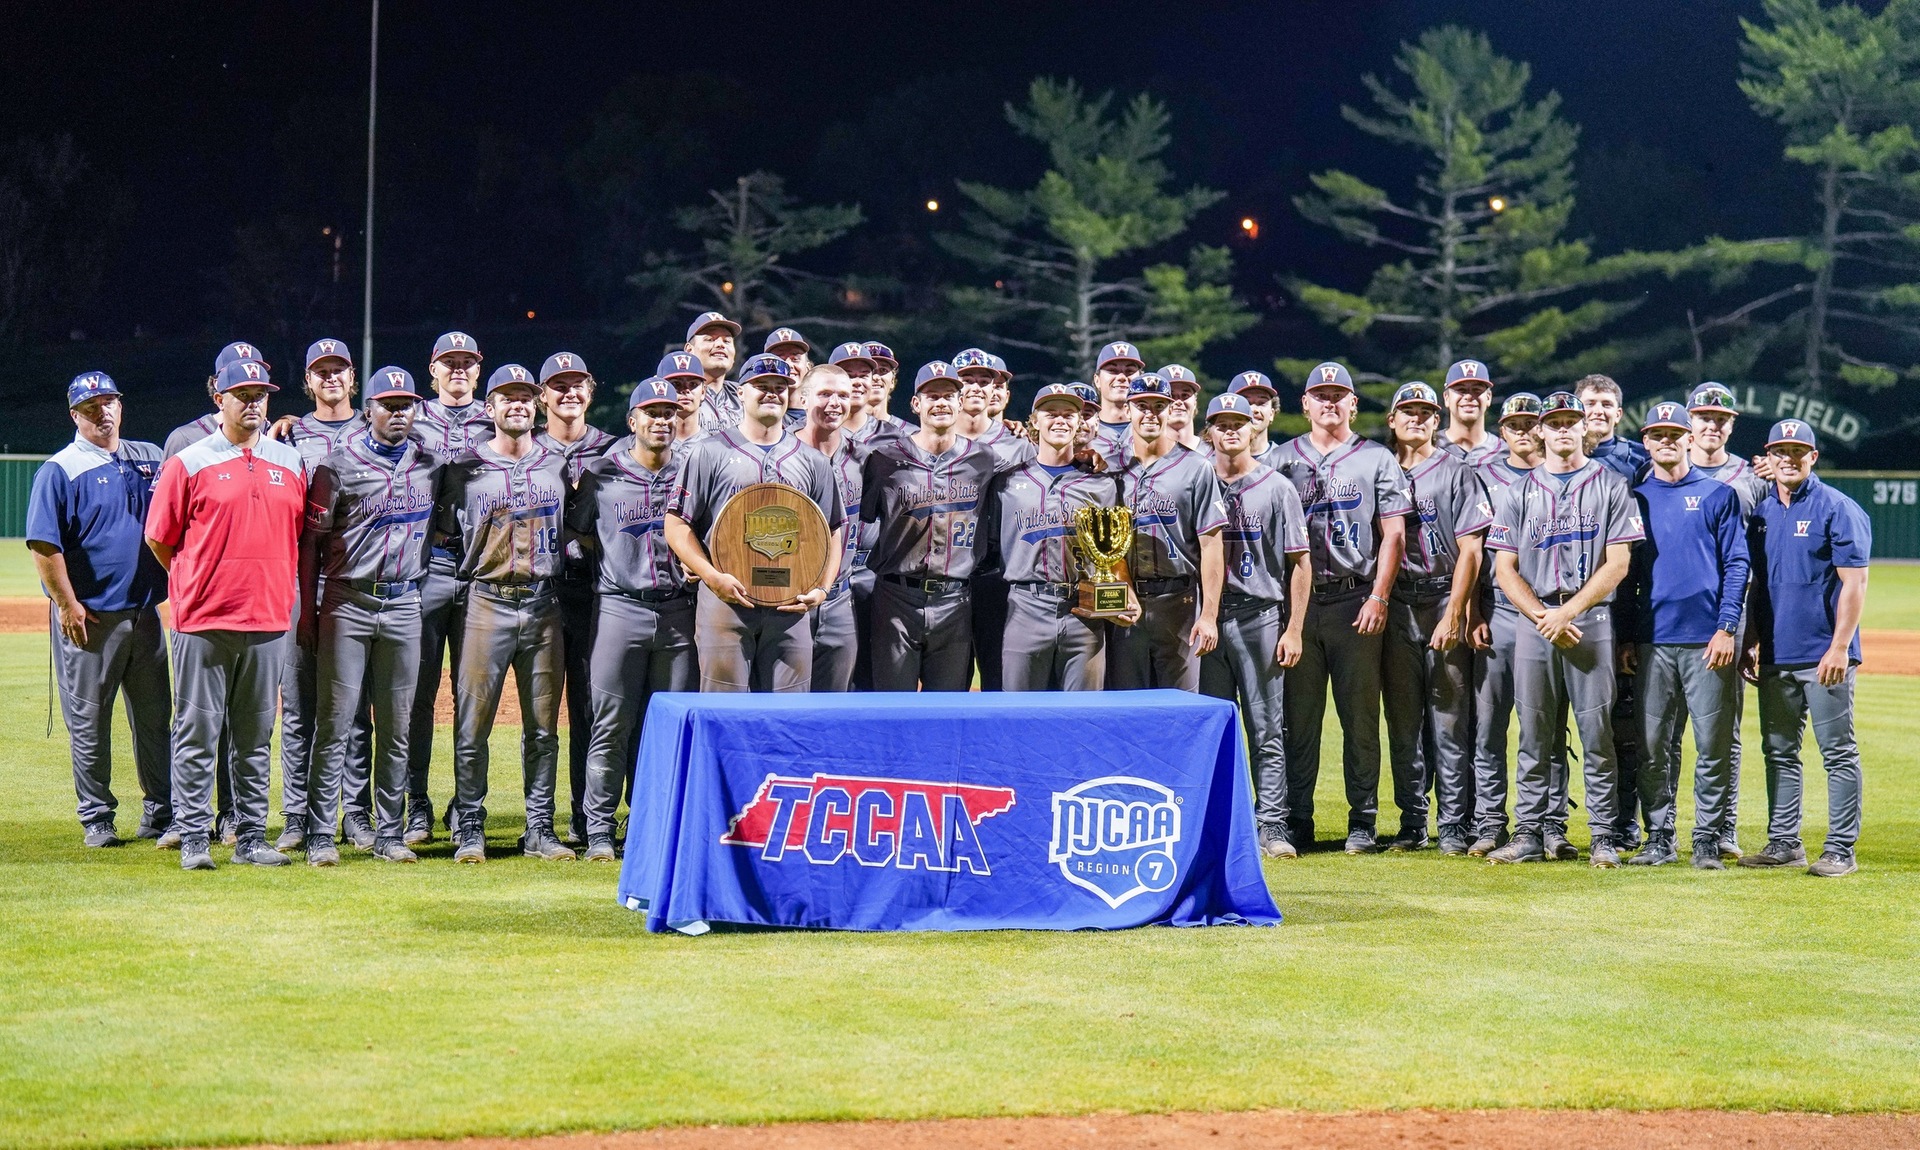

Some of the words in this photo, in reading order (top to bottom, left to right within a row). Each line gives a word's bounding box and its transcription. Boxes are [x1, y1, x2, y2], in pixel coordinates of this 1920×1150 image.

[449, 333, 467, 347] W
[776, 329, 793, 341] W
[234, 344, 252, 358] W
[318, 342, 336, 353] W
[1112, 344, 1130, 357] W
[555, 355, 572, 369] W
[673, 355, 692, 370] W
[241, 363, 260, 379] W
[508, 367, 527, 381] W
[928, 363, 948, 377] W
[1168, 365, 1185, 379] W
[1320, 367, 1339, 382] W
[1460, 363, 1479, 377] W
[84, 376, 99, 390] W
[386, 371, 405, 388] W
[1243, 373, 1262, 386] W
[650, 381, 667, 396] W
[1219, 397, 1239, 408] W
[1657, 405, 1675, 420] W
[1776, 392, 1860, 443] FIELD
[1781, 423, 1800, 437] W
[899, 483, 947, 508] Walters
[950, 478, 979, 500] State
[1330, 477, 1358, 499] State
[477, 489, 527, 516] Walters
[530, 483, 559, 505] State
[614, 500, 664, 525] Walters
[1014, 507, 1060, 532] Walters
[1235, 506, 1262, 530] State
[537, 526, 559, 555] 18
[952, 521, 976, 548] 22
[1331, 519, 1360, 550] 24
[786, 540, 792, 548] 7
[1240, 550, 1254, 578] 8
[1576, 552, 1588, 580] 4
[761, 784, 993, 878] TCCAA
[1056, 798, 1177, 858] NJCAA
[1077, 861, 1130, 875] REGION
[1148, 862, 1164, 881] 7
